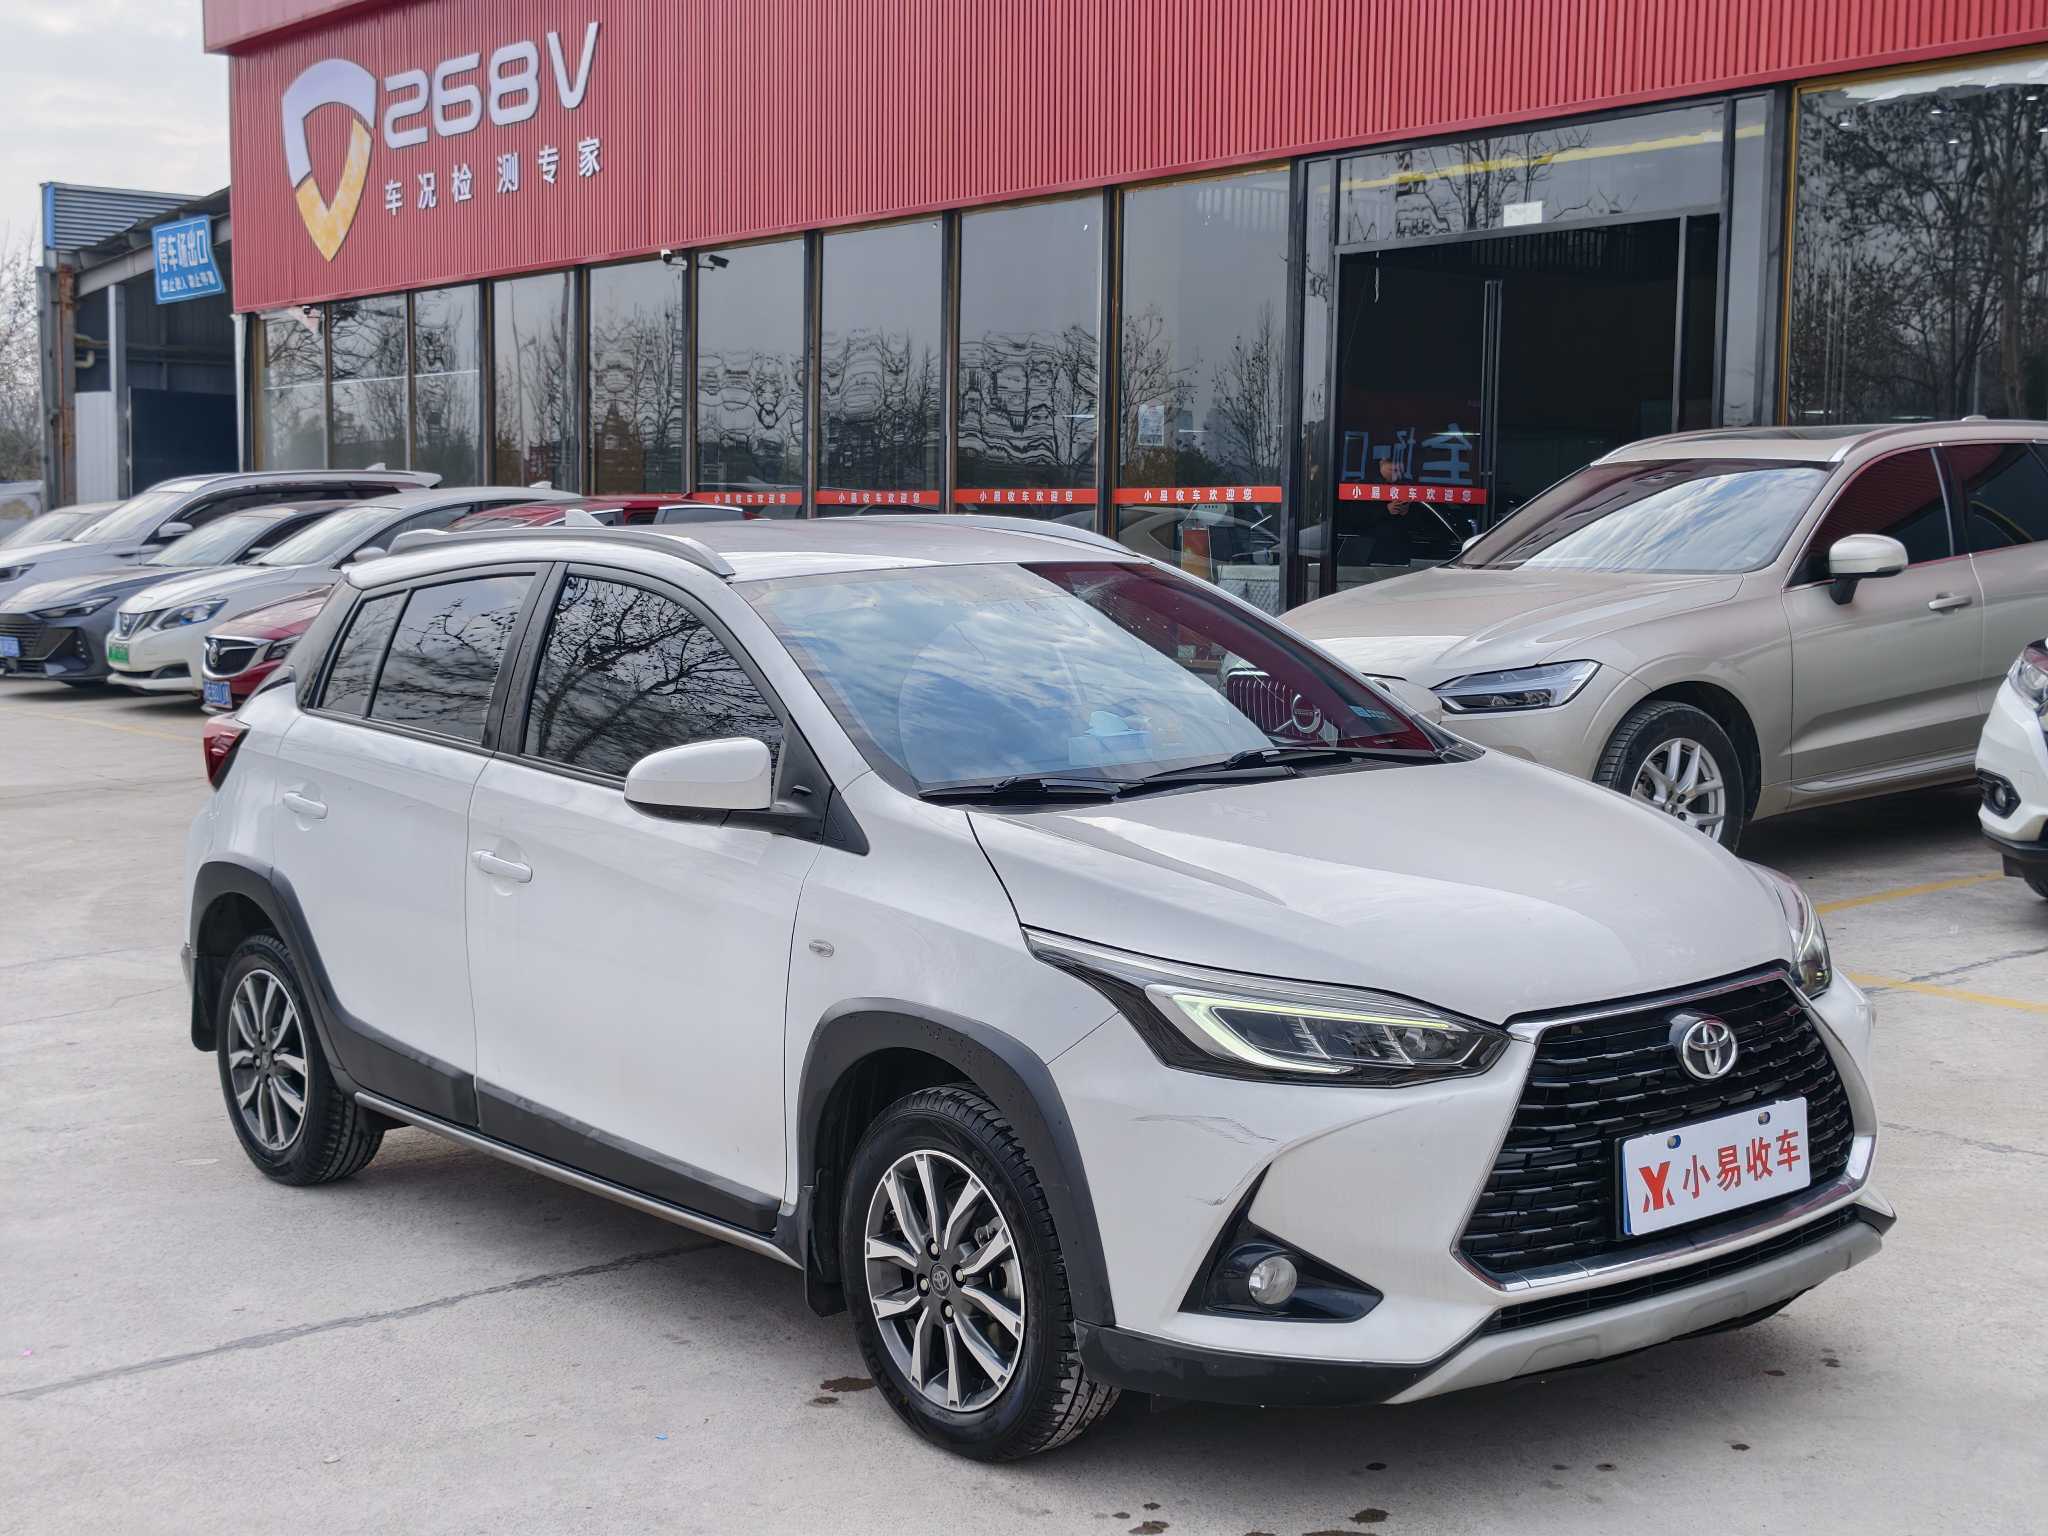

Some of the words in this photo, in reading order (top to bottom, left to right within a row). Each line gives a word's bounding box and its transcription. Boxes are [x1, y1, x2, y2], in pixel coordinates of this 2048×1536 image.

[383, 21, 600, 150] 268V
[384, 136, 602, 217] 车况检测专家
[158, 229, 209, 273] 停车场出口
[1143, 487, 1253, 502] 小易收车欢迎您
[1681, 1128, 1802, 1200] 小易收车
